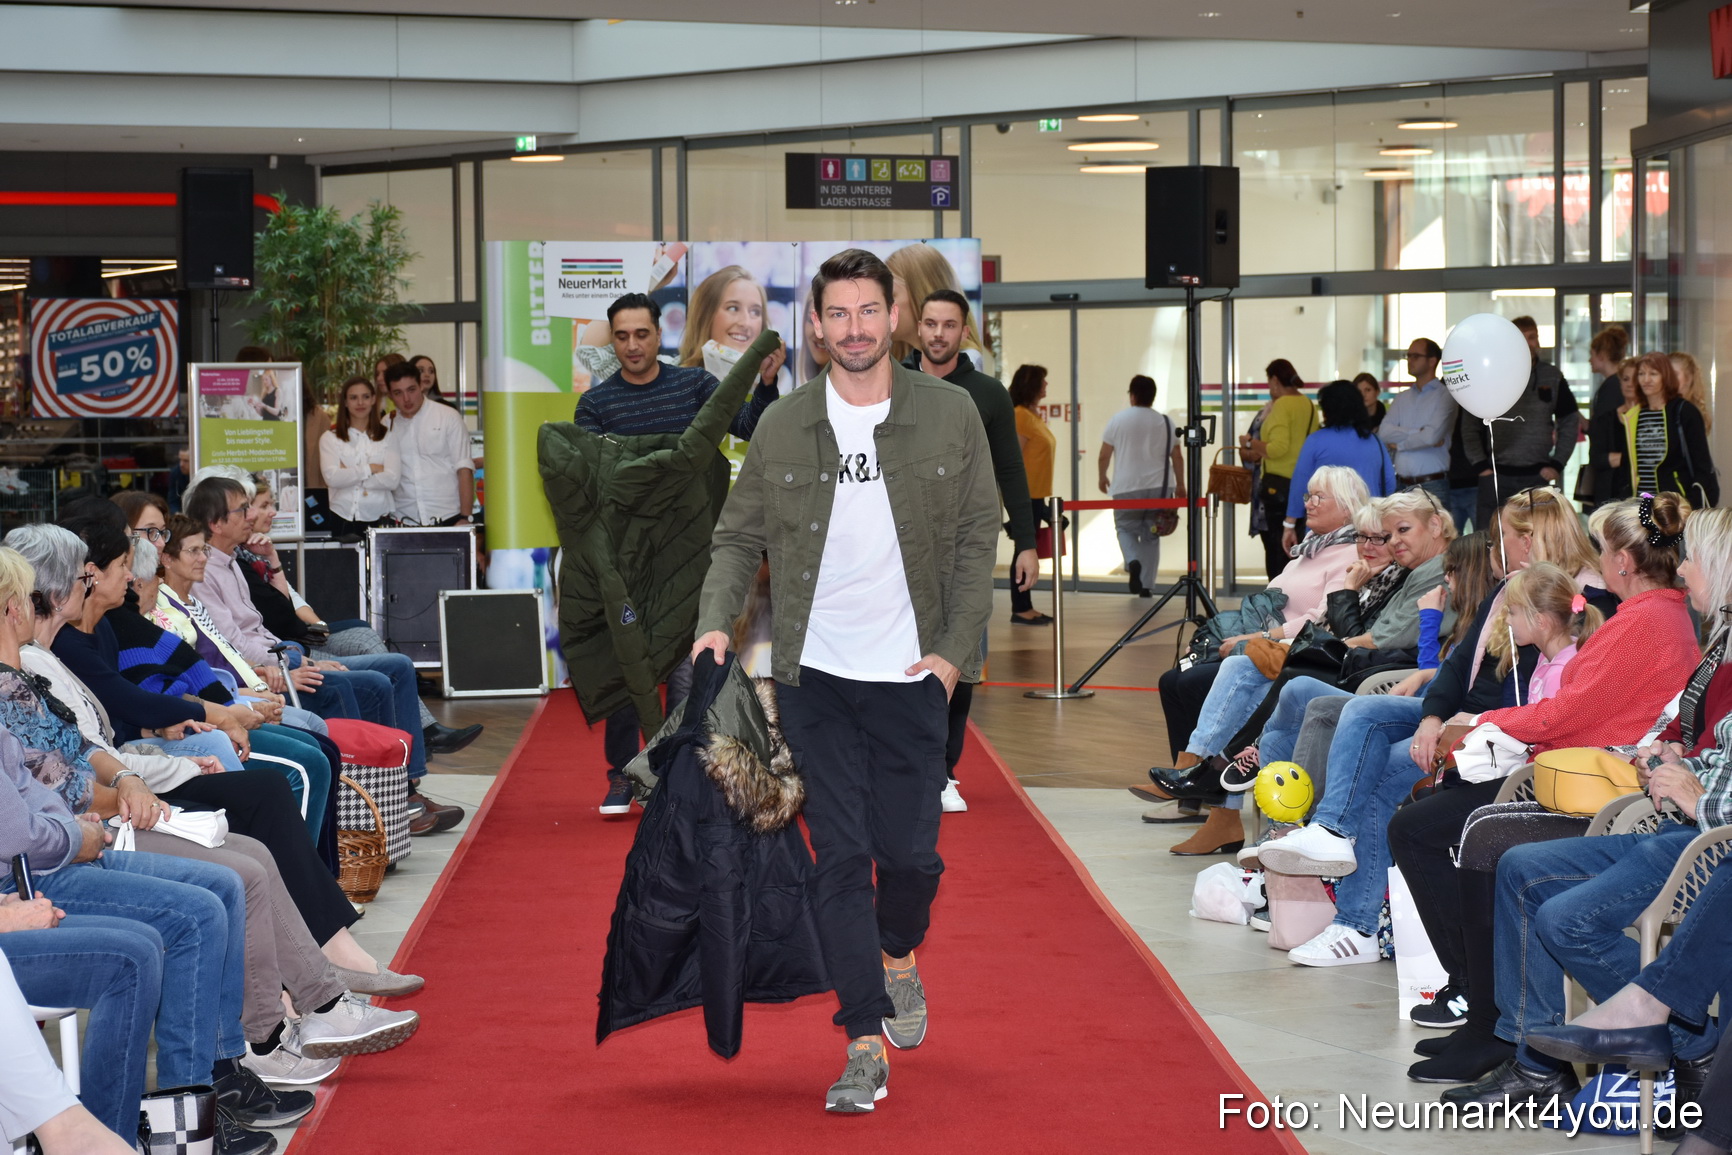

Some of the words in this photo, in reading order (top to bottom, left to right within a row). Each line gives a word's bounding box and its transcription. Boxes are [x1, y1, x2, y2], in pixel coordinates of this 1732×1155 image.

[820, 185, 829, 194] IN
[831, 185, 847, 194] DER
[851, 186, 892, 195] UNTEREN
[820, 197, 892, 207] LADENSTRASSE
[558, 278, 627, 289] NeuerMarkt
[237, 428, 274, 437] Lieblingsteil
[226, 448, 286, 456] Herbst-Modenschau
